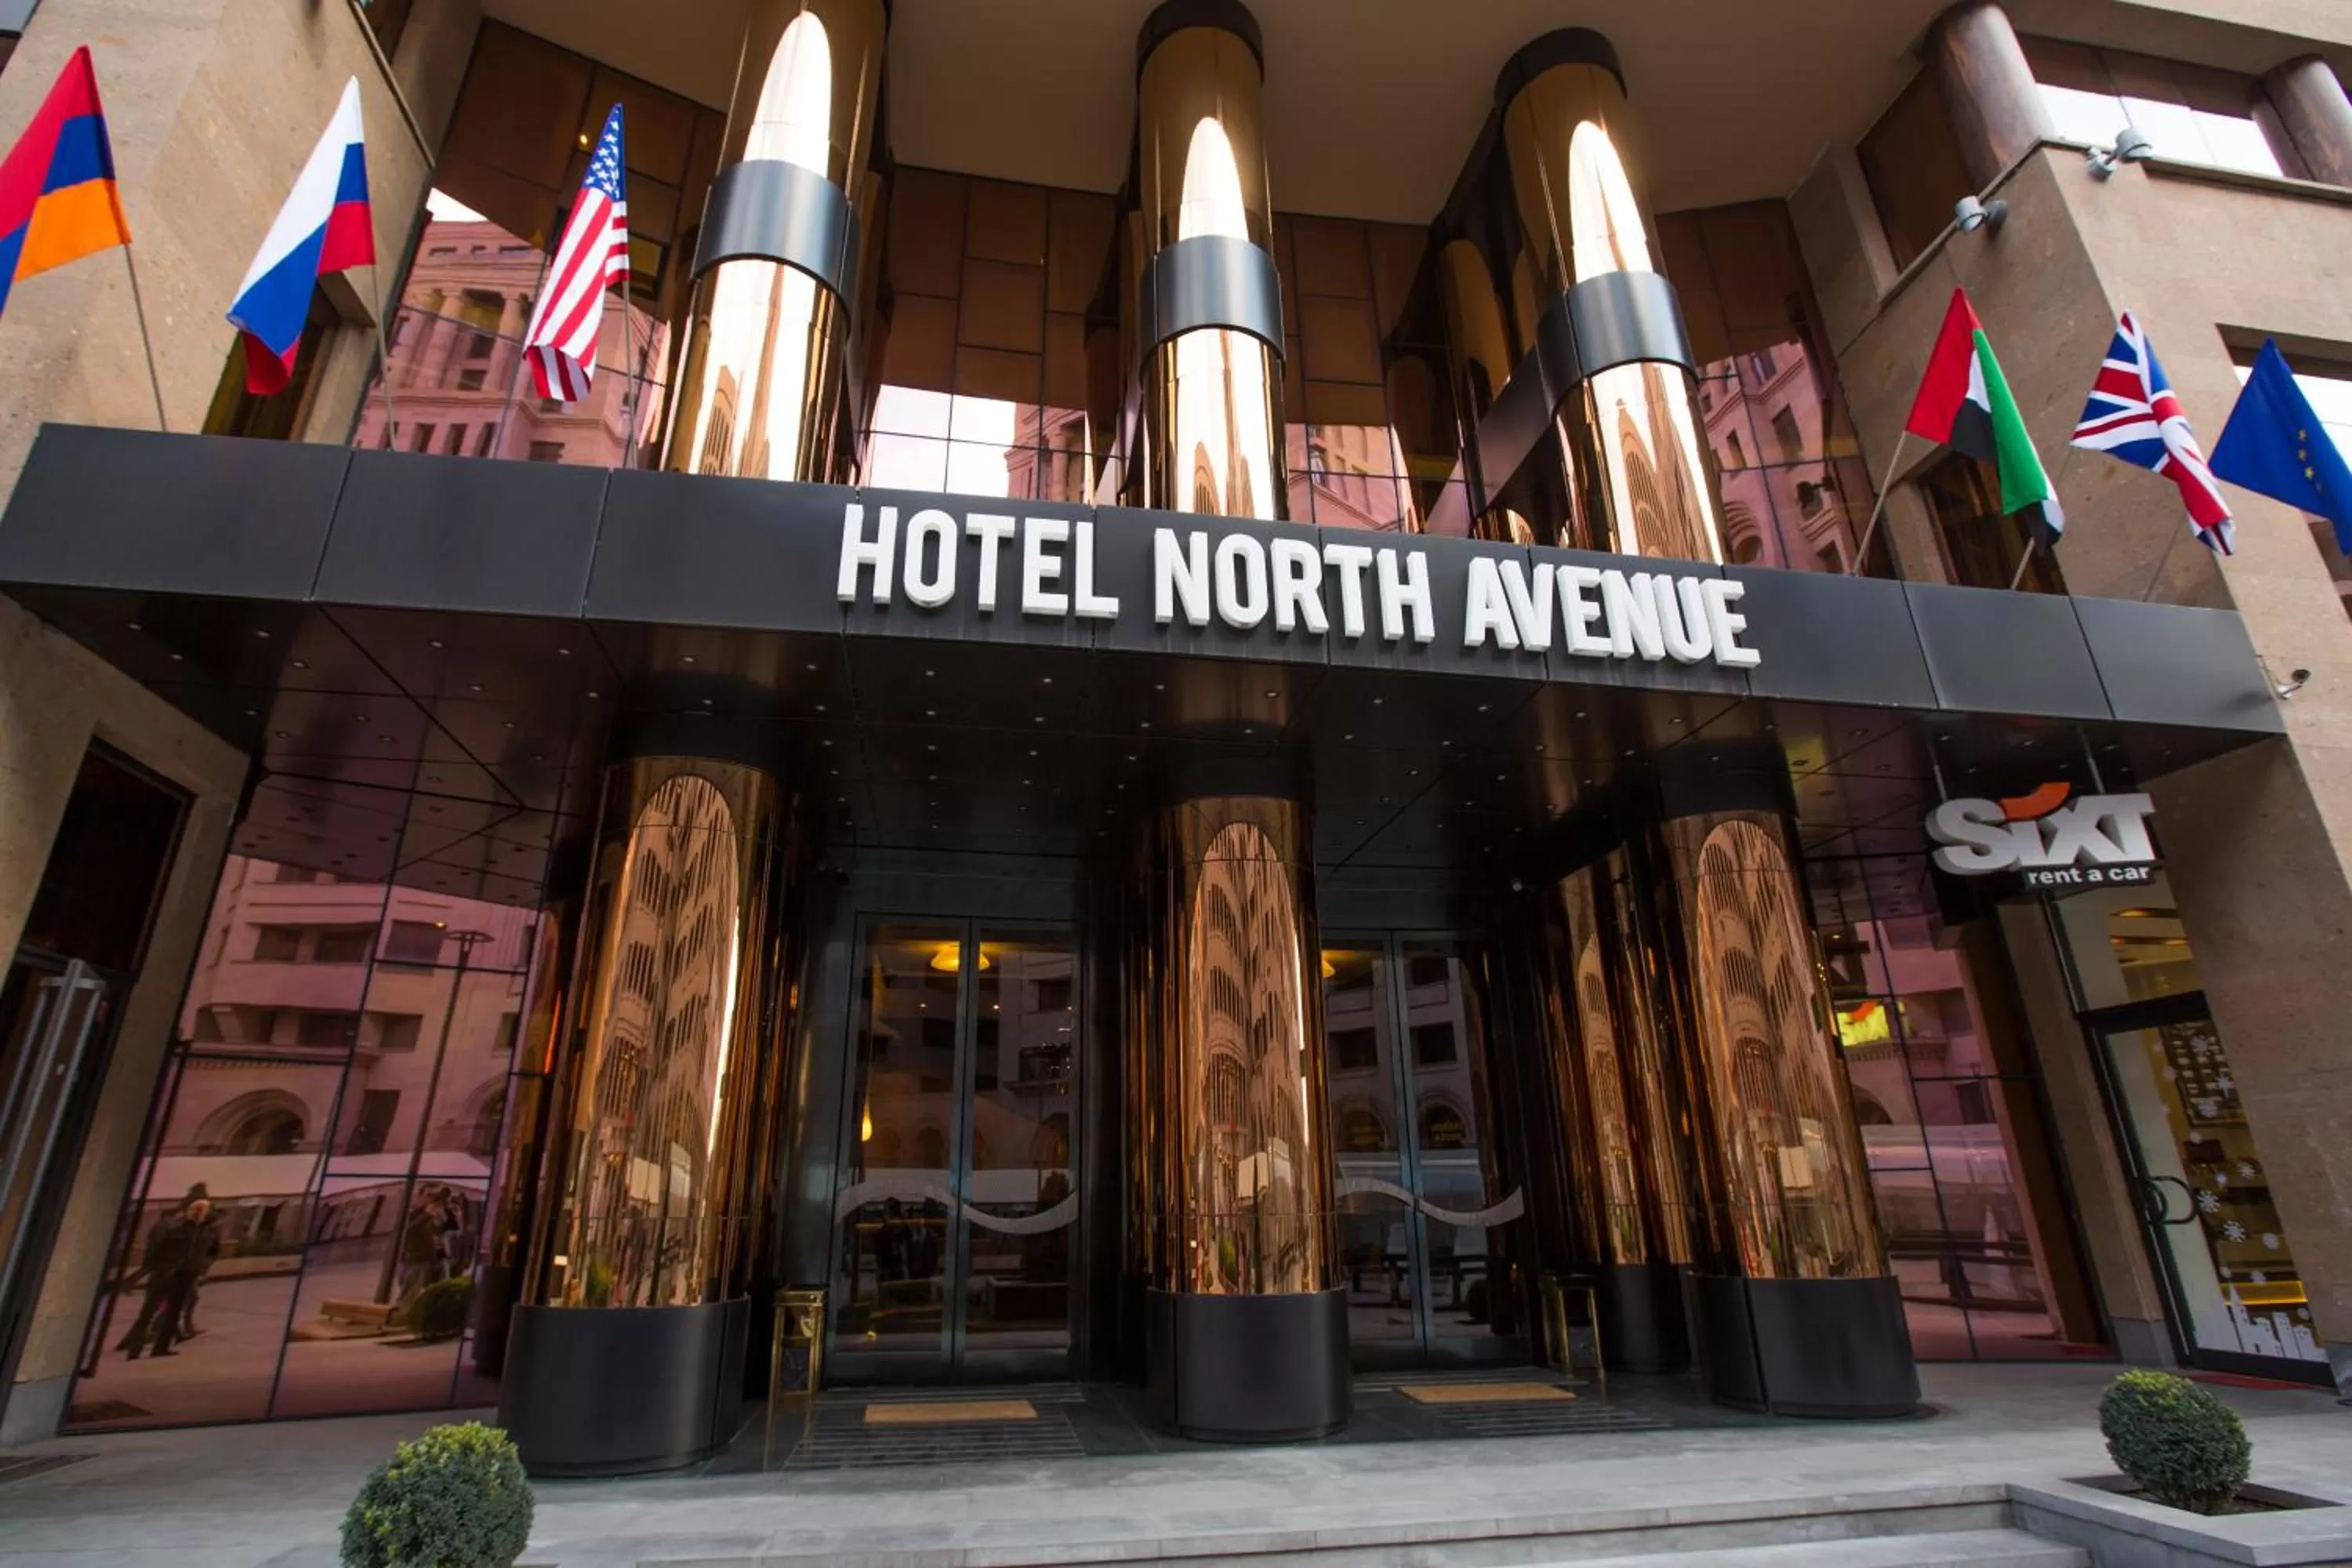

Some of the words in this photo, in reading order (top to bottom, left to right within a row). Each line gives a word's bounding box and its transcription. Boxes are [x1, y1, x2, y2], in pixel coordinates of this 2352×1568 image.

[837, 503, 1120, 619] HOTEL
[1153, 528, 1436, 641] NORTH
[1464, 557, 1761, 666] AVENUE
[2027, 866, 2082, 885] rent
[2089, 867, 2103, 882] a
[2109, 866, 2149, 882] car
